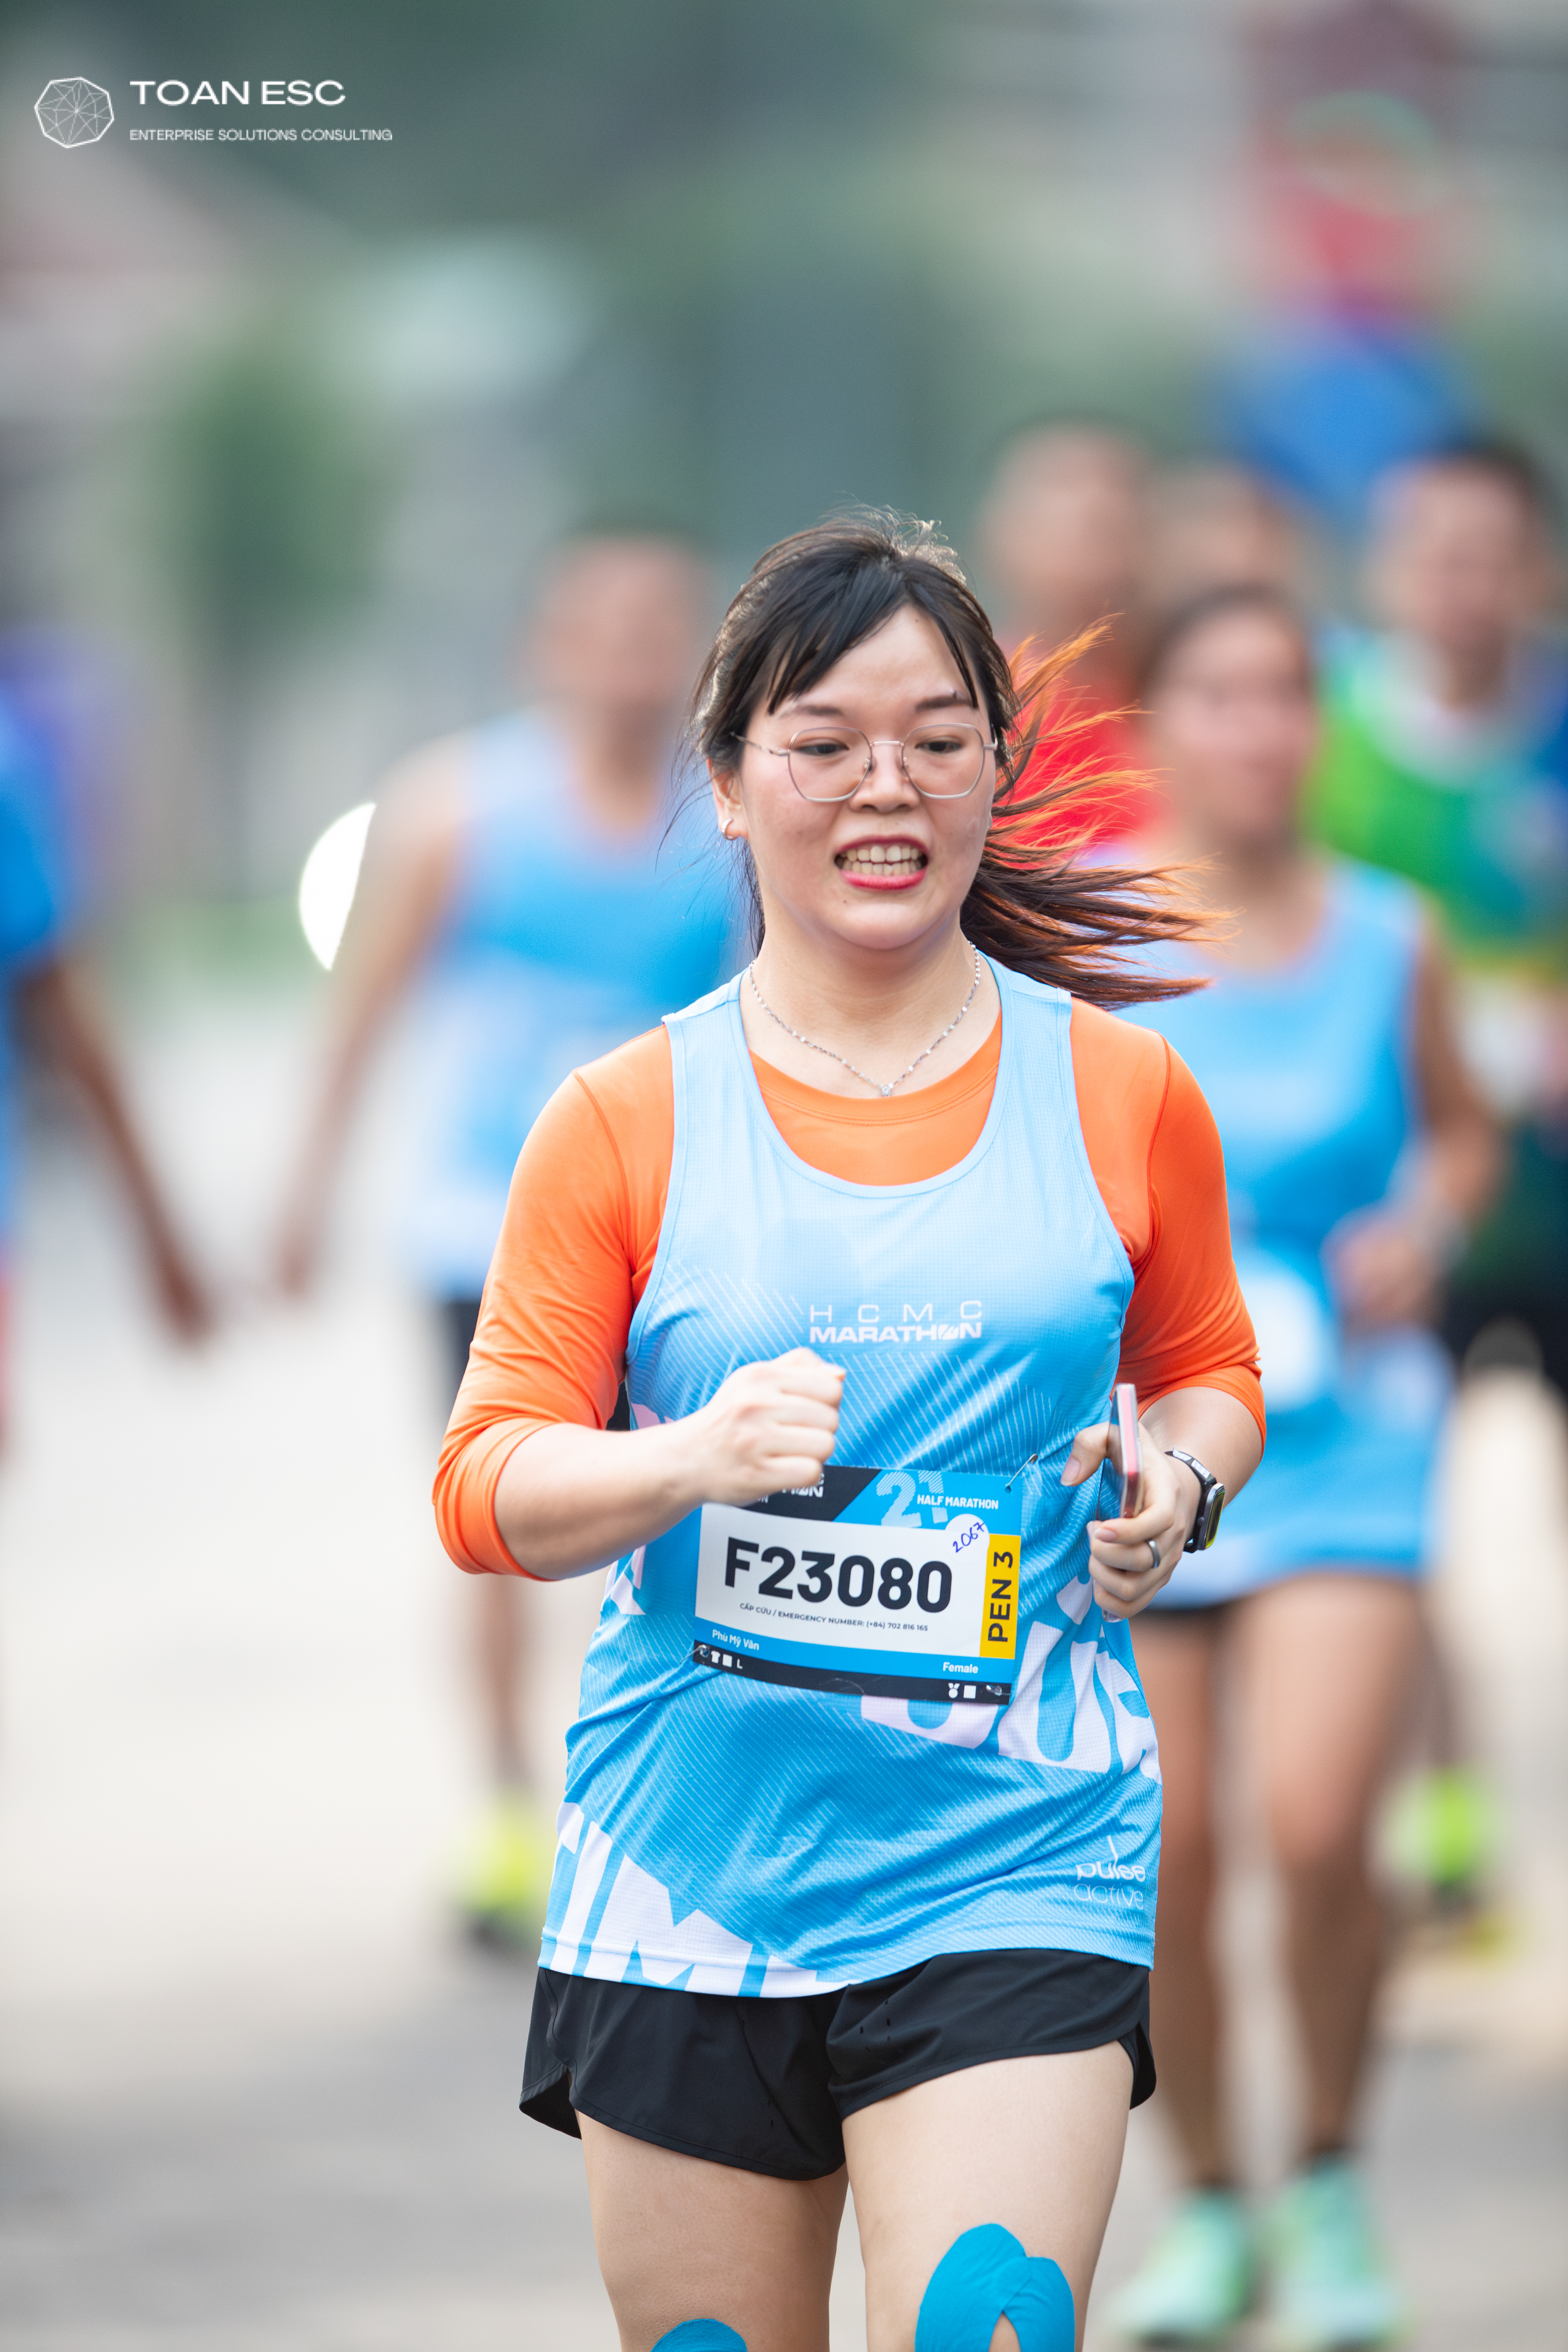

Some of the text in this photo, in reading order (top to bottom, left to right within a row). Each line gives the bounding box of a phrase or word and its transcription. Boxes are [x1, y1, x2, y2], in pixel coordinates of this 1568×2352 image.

[917, 1494, 999, 1510] HALF MARATHON
[953, 1522, 985, 1553] 2067
[725, 1537, 953, 1613] F23080
[988, 1551, 1013, 1642] PEN 3
[778, 1611, 827, 1622] EMERGENCY
[828, 1617, 865, 1626] NUMBER:
[866, 1620, 885, 1630] (+84)
[737, 1658, 743, 1669] L
[943, 1661, 979, 1674] Female
[1075, 1835, 1146, 1882] pulse
[1074, 1883, 1143, 1910] active
